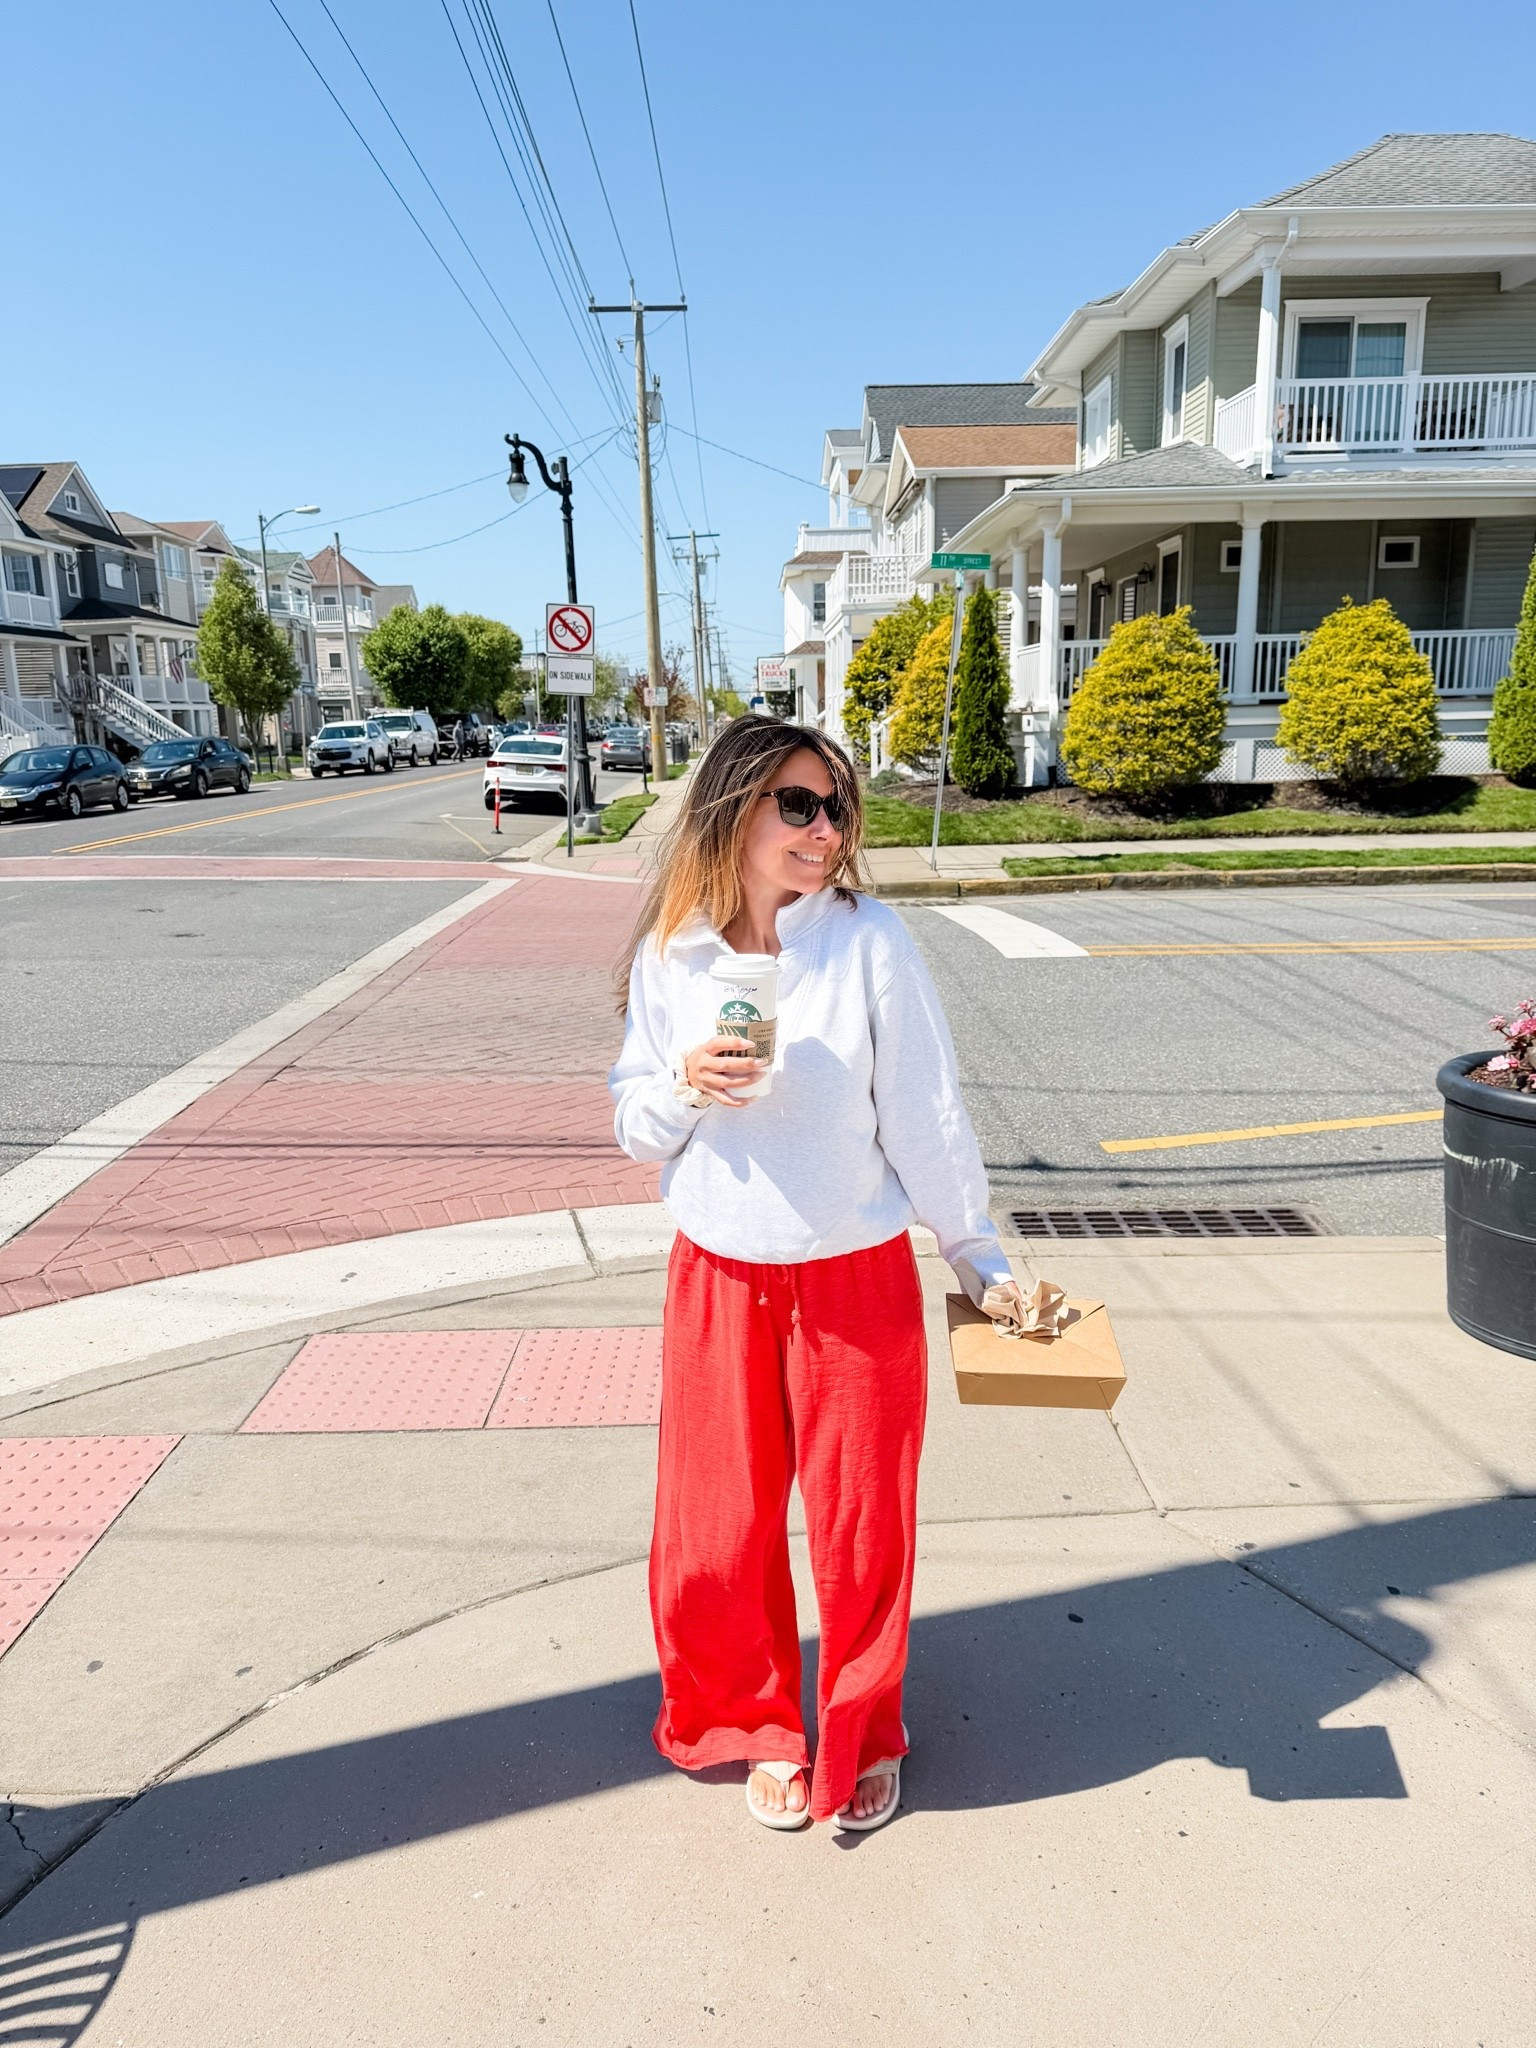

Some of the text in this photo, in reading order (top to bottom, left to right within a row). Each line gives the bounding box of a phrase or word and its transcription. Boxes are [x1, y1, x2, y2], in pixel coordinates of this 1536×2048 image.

[963, 557, 982, 565] STREET
[549, 671, 592, 681] ON SIDEWALK
